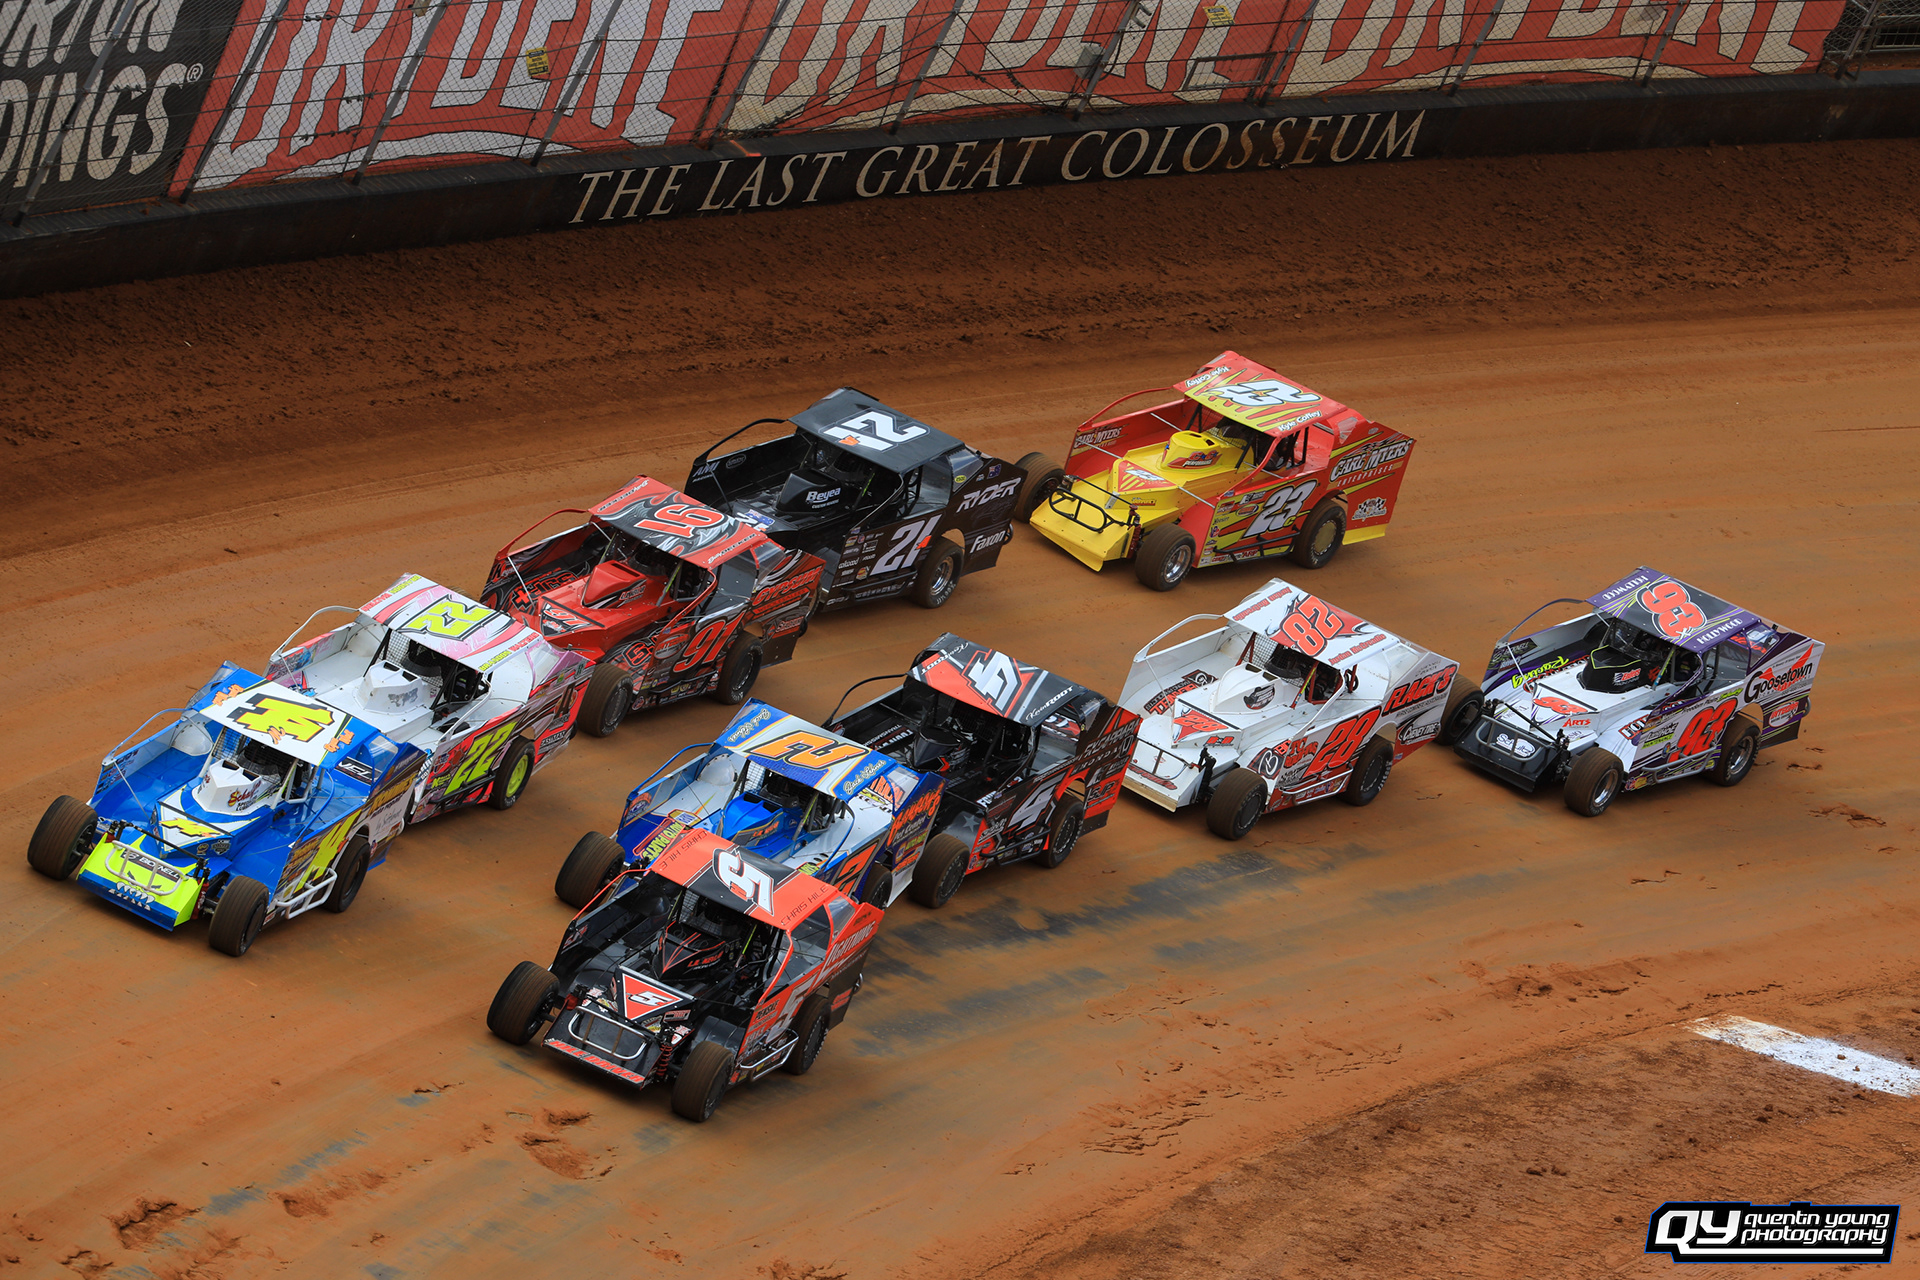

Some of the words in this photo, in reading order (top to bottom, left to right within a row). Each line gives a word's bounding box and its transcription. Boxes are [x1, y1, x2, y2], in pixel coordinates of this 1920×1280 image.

[568, 164, 690, 225] THE
[697, 151, 849, 213] LAST
[855, 135, 1053, 199] GREAT
[1060, 108, 1428, 183] COLOSSEUM
[1211, 365, 1231, 379] Kyle
[1206, 379, 1321, 406] 23
[822, 410, 928, 452] 21
[1277, 420, 1297, 432] Kyle
[1295, 410, 1321, 425] Coffey
[1330, 452, 1368, 481] CARL
[1363, 439, 1413, 472] MYERS
[806, 487, 842, 504] Beyea
[956, 477, 1022, 513] RYDER
[1242, 479, 1317, 538] 23
[633, 503, 726, 539] 91
[869, 513, 943, 577] 21
[969, 530, 1006, 554] Faxon
[389, 574, 423, 595] BRANDON
[1602, 575, 1649, 601] HOLLYWOOD
[400, 600, 496, 640] 22
[1280, 595, 1344, 657] 28
[1641, 580, 1706, 638] 93
[673, 610, 747, 673] 91
[1696, 617, 1744, 645] HOLLYWOOD
[478, 650, 513, 672] BRANDON
[920, 654, 949, 676] ROOT
[1511, 655, 1570, 689] Racing
[966, 650, 1019, 712] 4
[1044, 685, 1075, 708] ROOT
[1384, 665, 1457, 714] FLACK'S
[1743, 661, 1814, 704] Goosetown
[1562, 717, 1592, 728] ARTS
[443, 720, 519, 797] 22
[1303, 707, 1381, 779] 28
[1005, 771, 1068, 833] 4
[640, 833, 671, 863] PARTS
[680, 830, 709, 852] CHRIS
[658, 850, 682, 871] HILE
[781, 903, 809, 927] CHRIS
[807, 885, 830, 904] HILE
[550, 1039, 587, 1059] HILE
[584, 1053, 645, 1084] DRIVER
